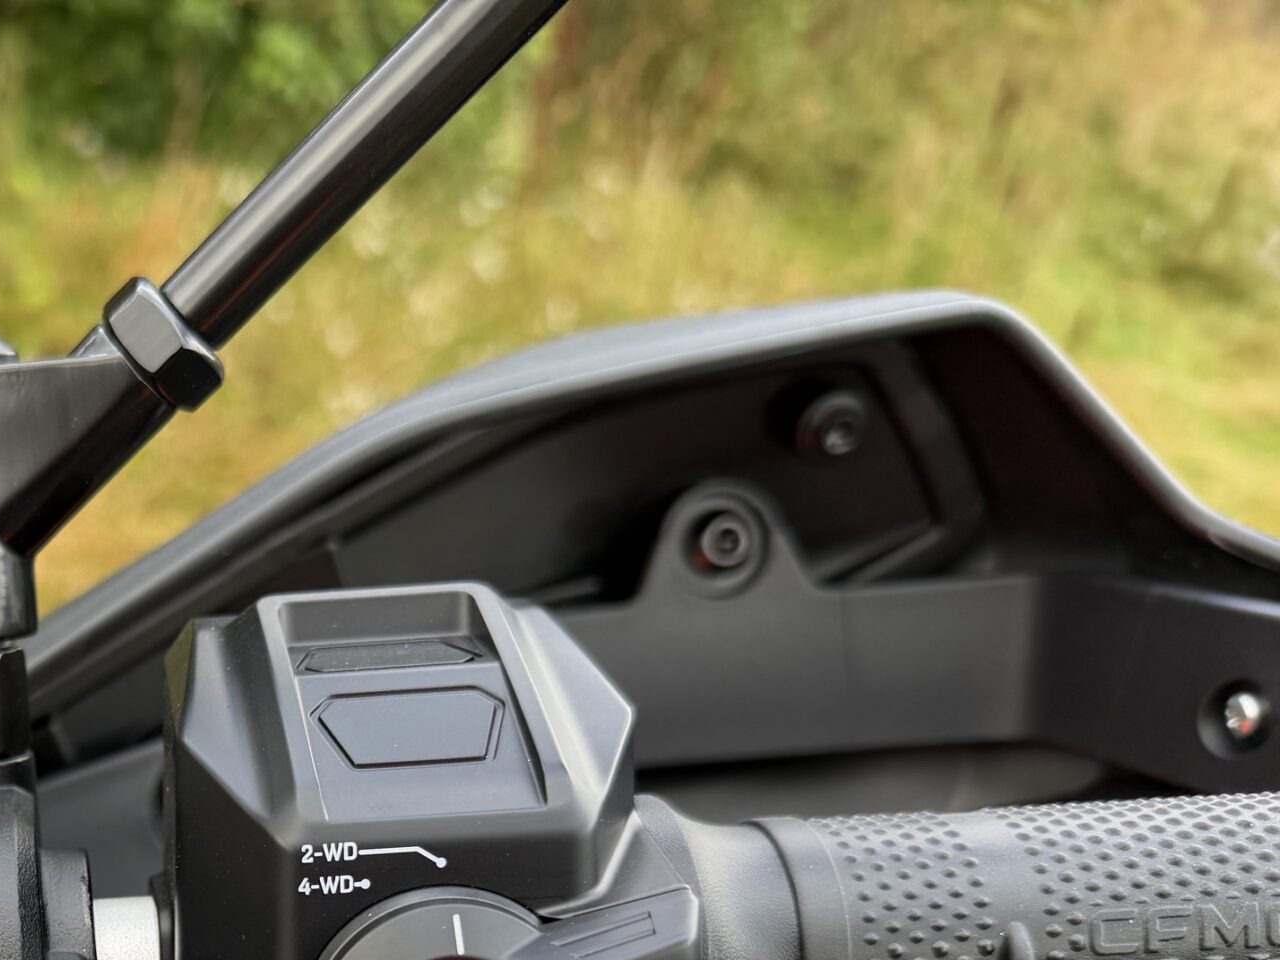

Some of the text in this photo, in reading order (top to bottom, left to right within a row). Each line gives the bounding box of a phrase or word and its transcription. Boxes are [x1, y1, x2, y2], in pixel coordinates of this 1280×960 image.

[301, 841, 358, 863] 2-WD
[297, 874, 354, 895] 4-WD
[1089, 902, 1280, 956] CFM
